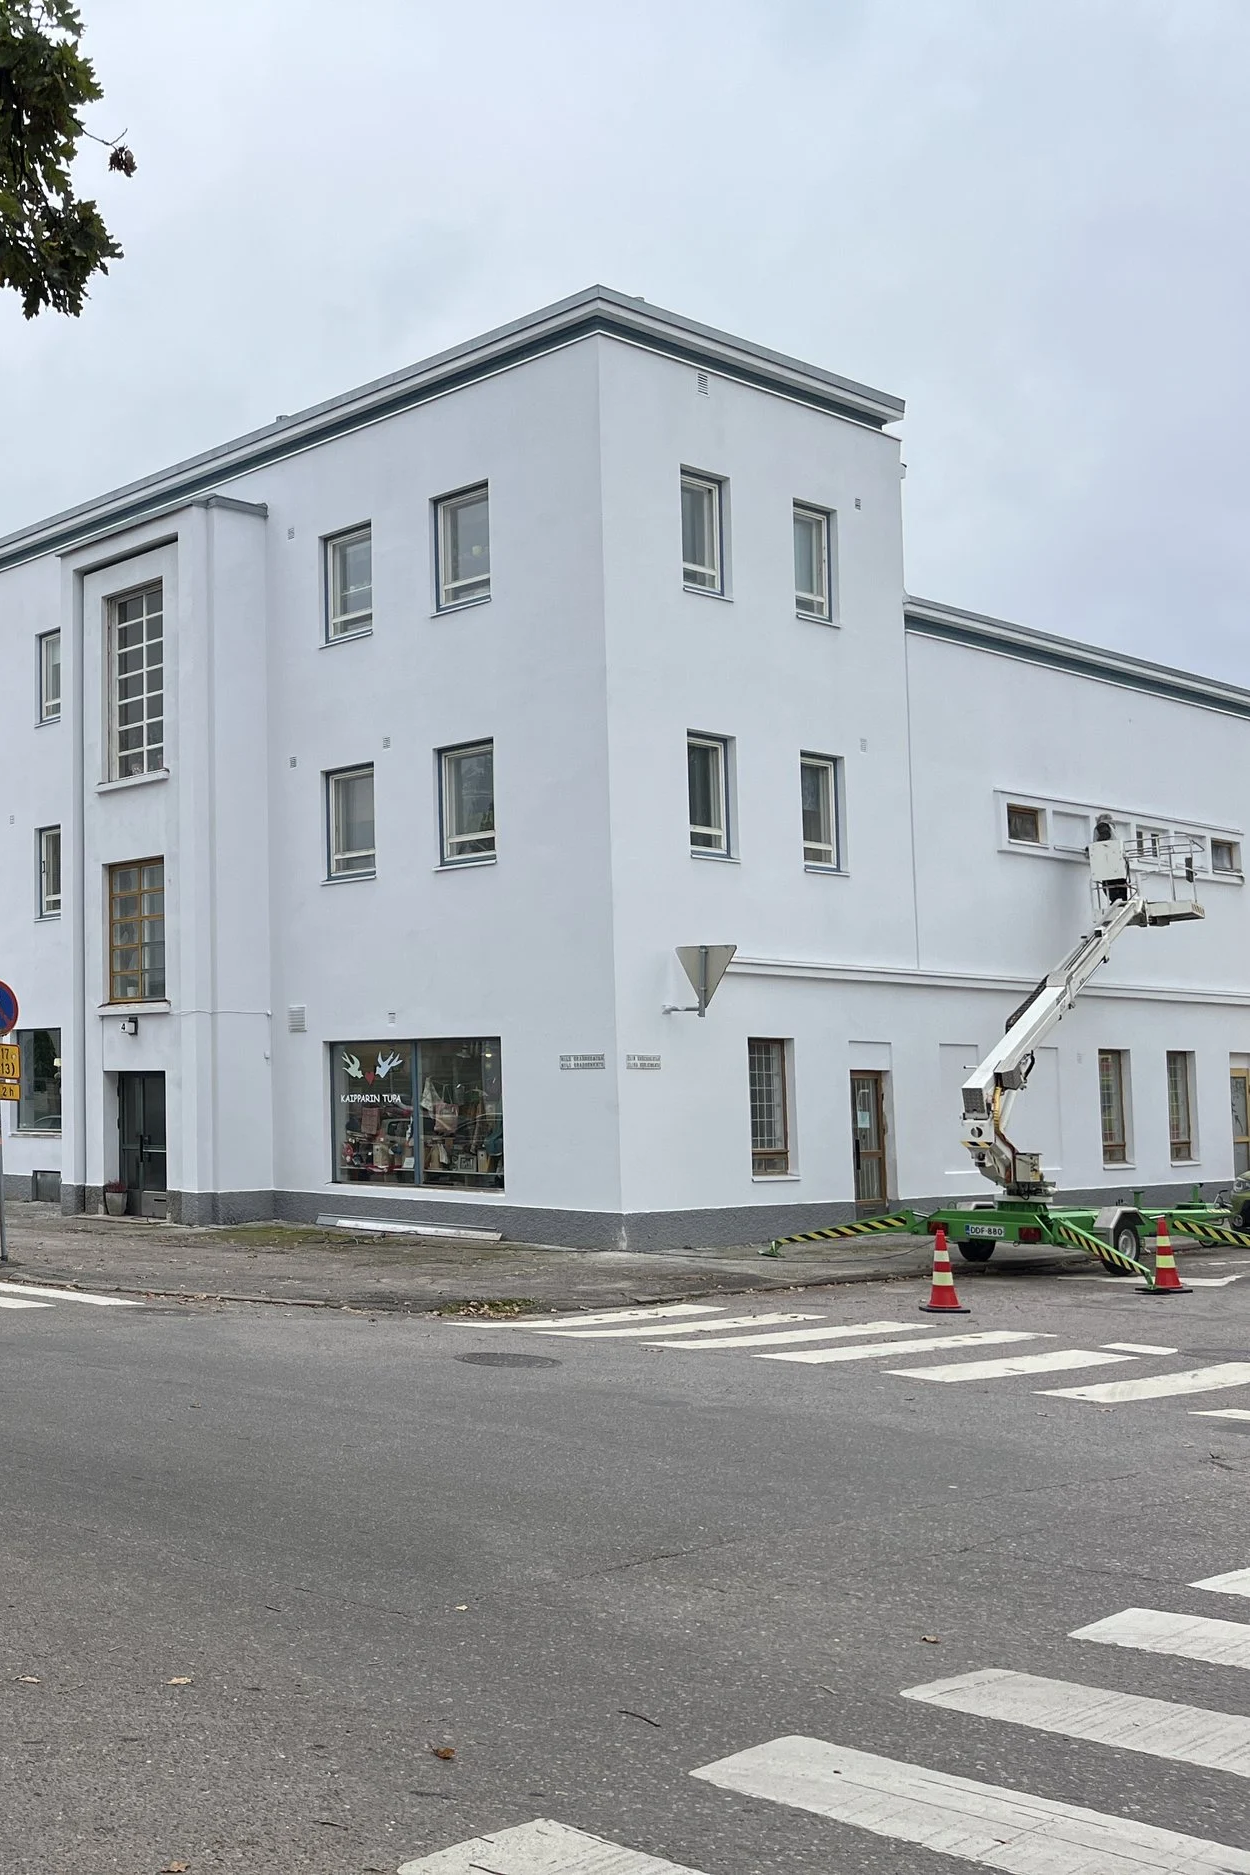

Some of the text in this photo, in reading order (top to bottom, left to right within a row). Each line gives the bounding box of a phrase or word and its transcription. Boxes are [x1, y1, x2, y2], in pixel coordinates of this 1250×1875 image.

[2, 1087, 14, 1096] 2 h
[340, 1094, 401, 1103] KAIPPARIN TUPA
[970, 1226, 1003, 1236] DDF-880
